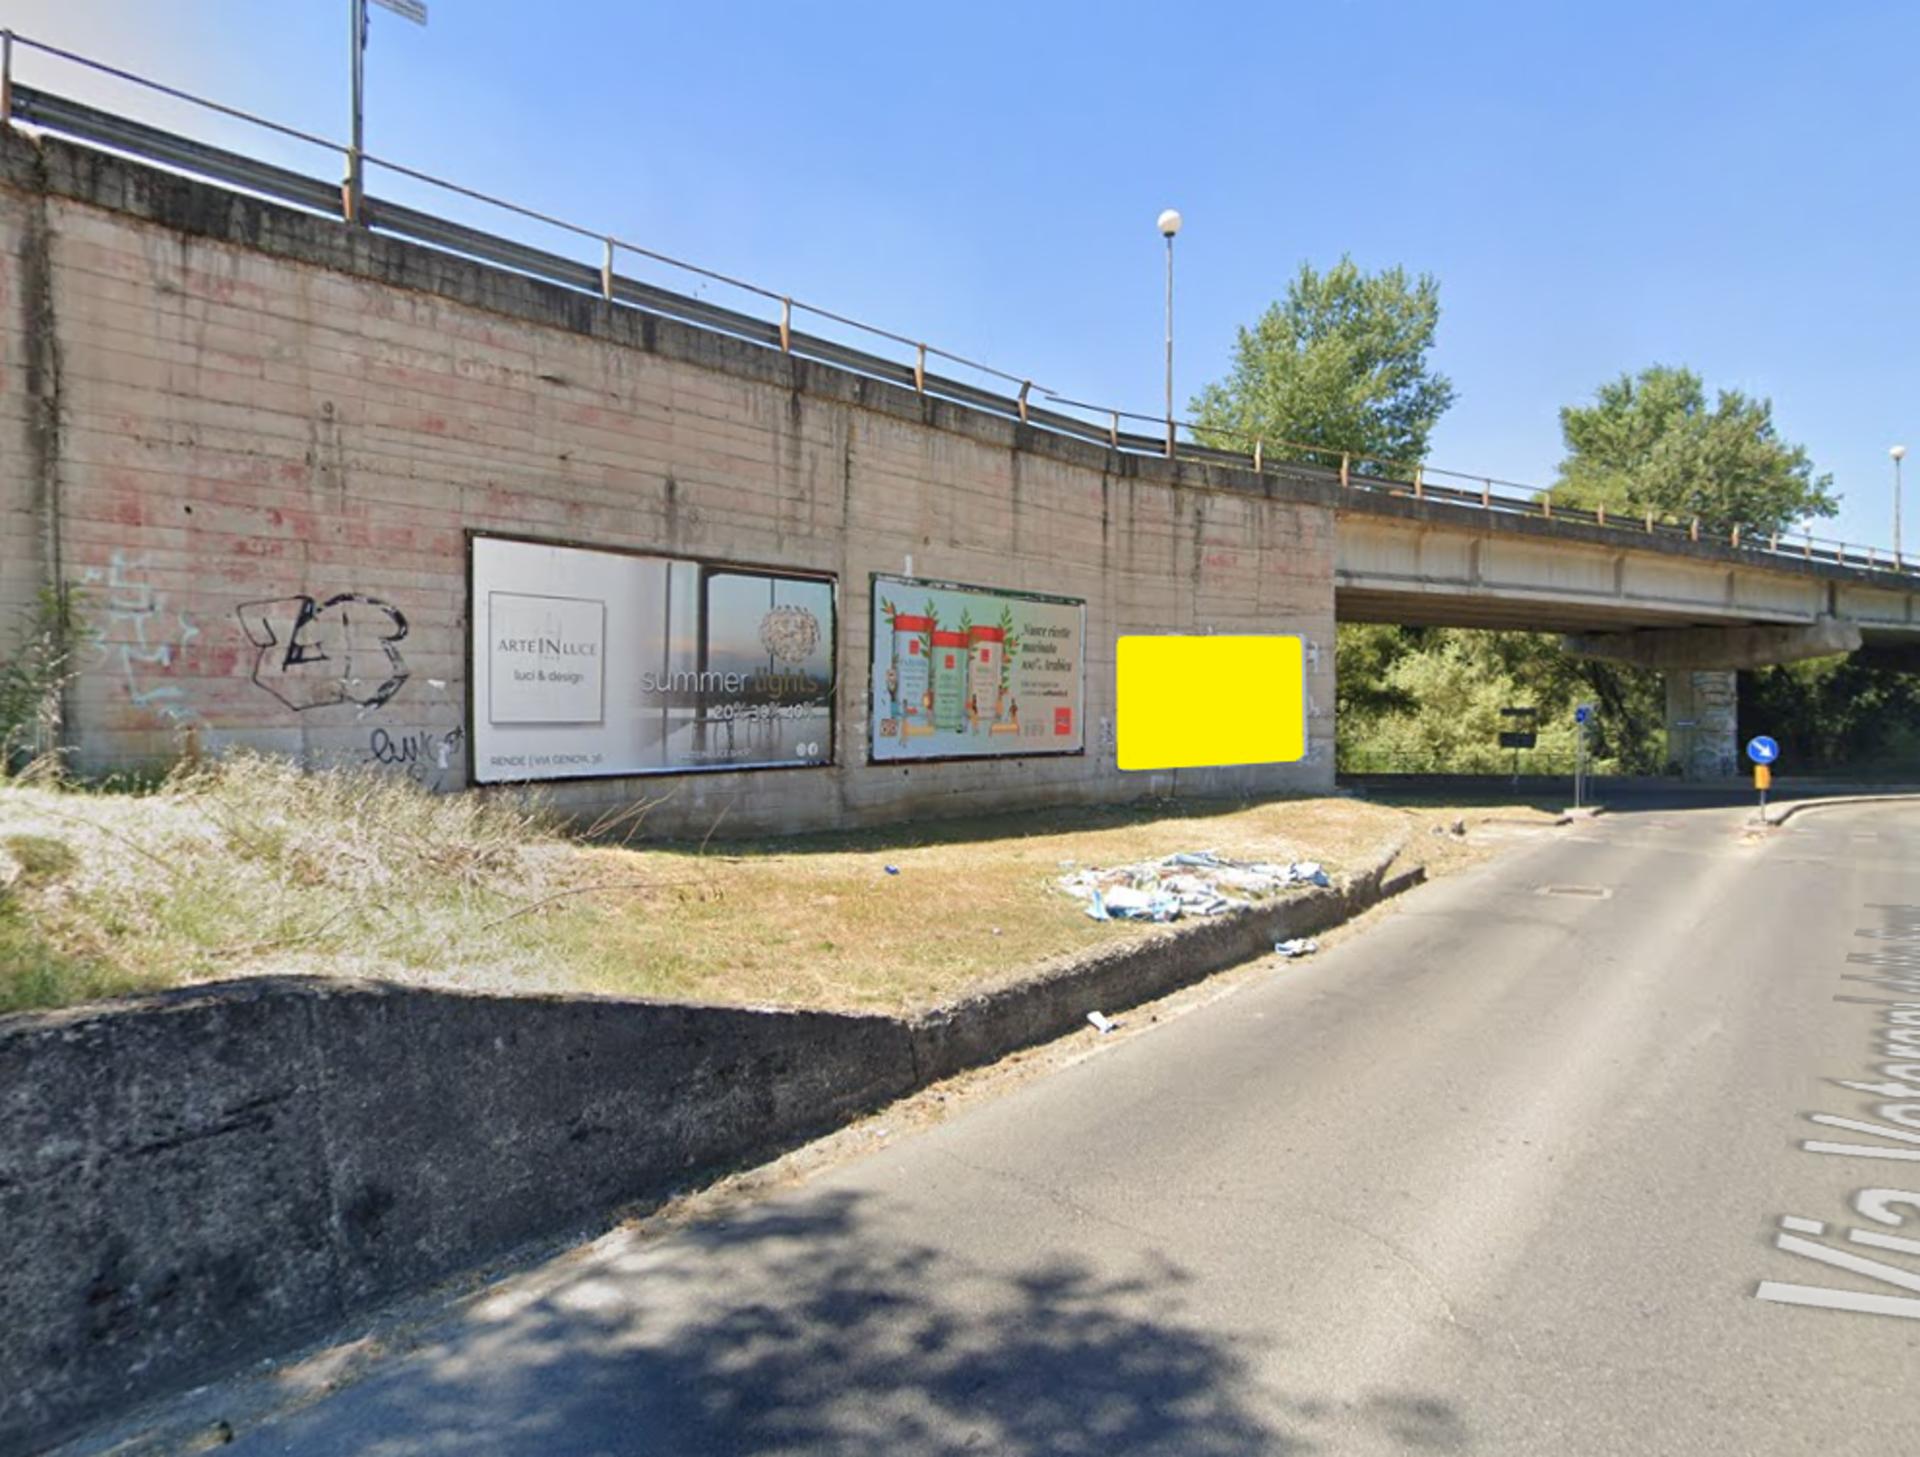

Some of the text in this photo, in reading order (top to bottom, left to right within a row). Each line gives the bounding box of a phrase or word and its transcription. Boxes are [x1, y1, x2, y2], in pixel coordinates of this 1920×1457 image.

[514, 669, 535, 681] luci
[548, 671, 584, 685] design
[641, 667, 818, 698] summer lights
